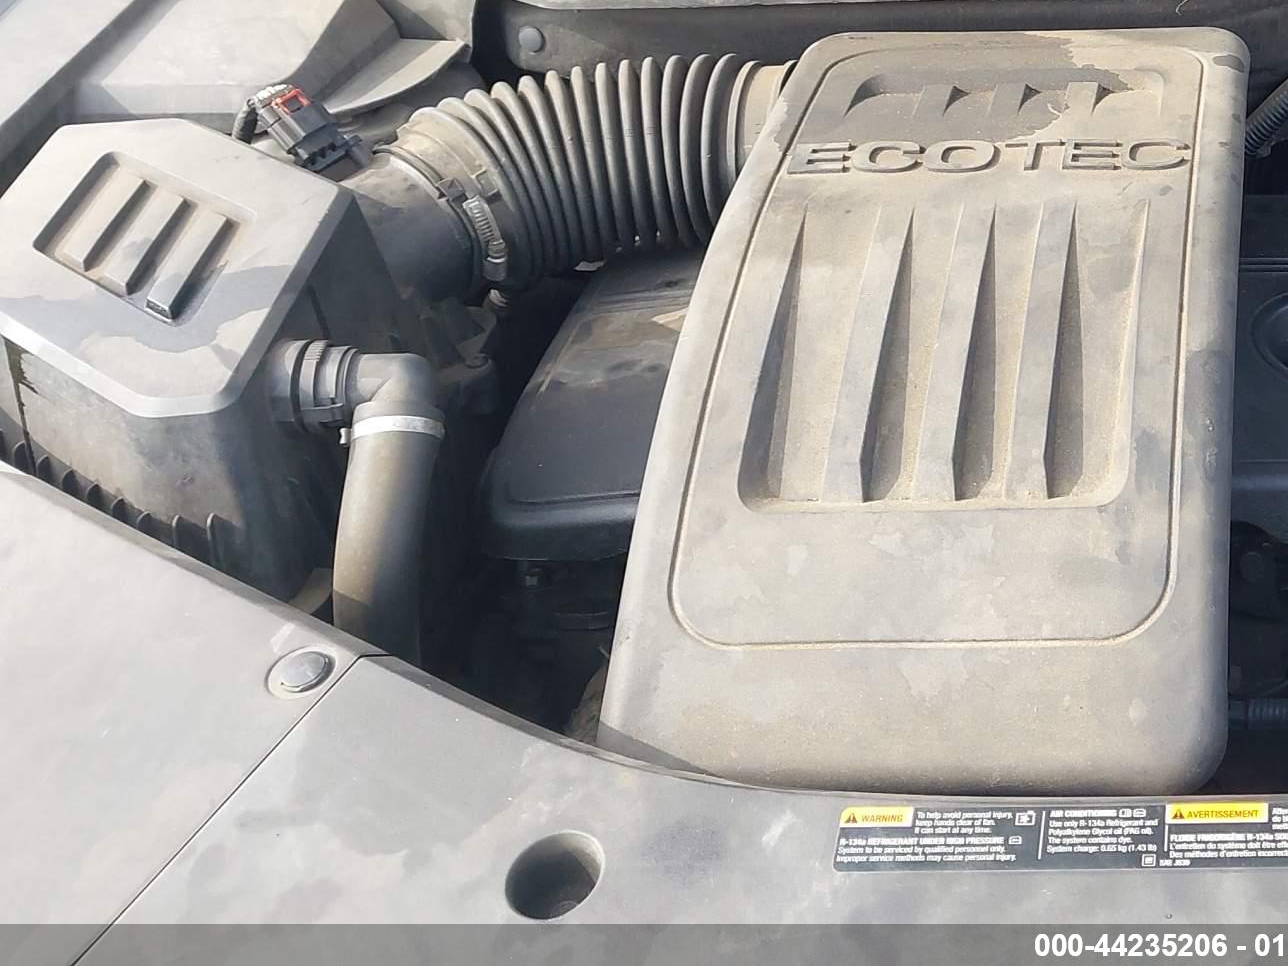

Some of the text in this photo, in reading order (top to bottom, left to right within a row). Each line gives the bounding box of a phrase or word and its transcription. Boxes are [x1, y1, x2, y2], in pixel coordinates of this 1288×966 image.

[786, 137, 1192, 175] ECOTEC
[861, 814, 904, 823] WARNING
[1186, 810, 1259, 819] AVERTISSEMENT
